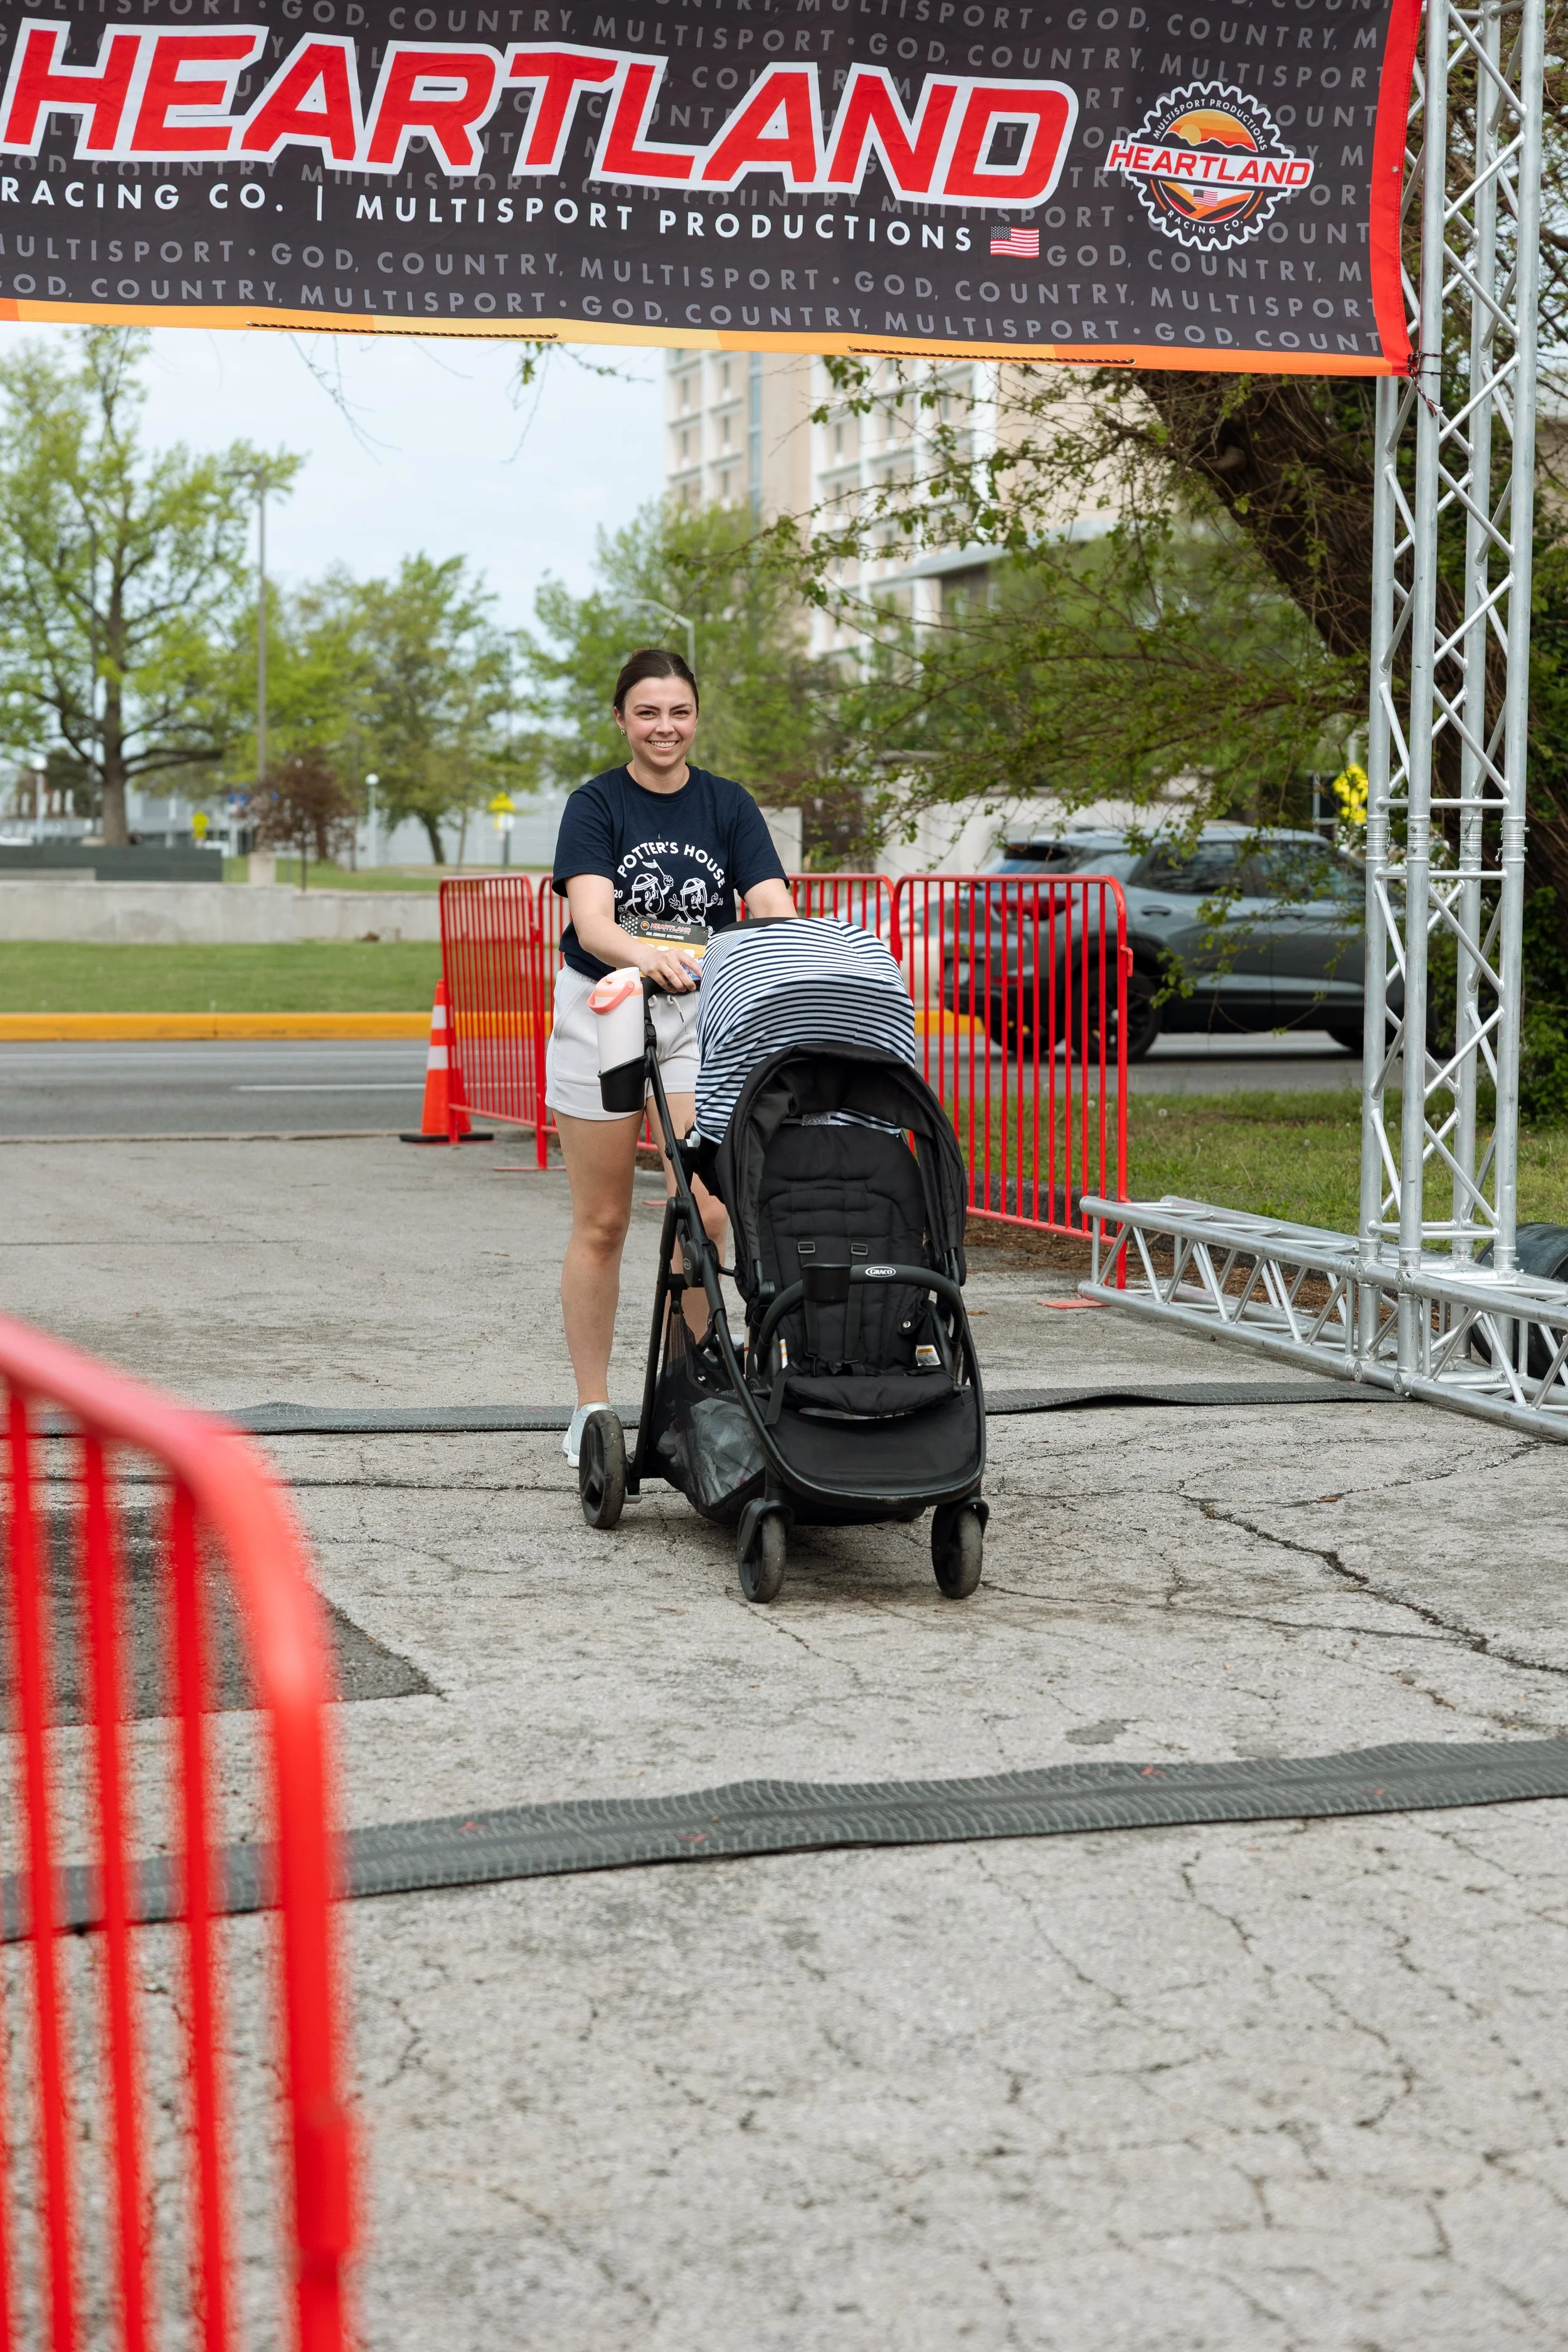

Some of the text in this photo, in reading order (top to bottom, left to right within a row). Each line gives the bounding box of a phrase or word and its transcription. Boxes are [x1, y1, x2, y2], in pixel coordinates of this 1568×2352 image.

[282, 0, 369, 28] GOD,
[389, 8, 576, 34] COUNTRY,
[593, 16, 834, 51] MULTISPORT
[869, 33, 949, 65] GOD,
[968, 44, 1145, 72] COUNTRY,
[1067, 8, 1150, 32] GOD,
[1167, 14, 1337, 50] COUNTRY,
[0, 17, 1079, 209] HEARTLAND
[1153, 98, 1205, 140] MULTISPORT
[1209, 98, 1267, 151] PRODUCTIONS
[1256, 103, 1377, 127] OUNT
[0, 154, 66, 174] OD
[1108, 144, 1310, 185] HEARTLAND
[1, 176, 971, 251] RACING CO. MULTISPORT PRODUCTIONS
[1167, 209, 1216, 235] RACING
[1224, 219, 1242, 232] CO.
[1249, 221, 1369, 244] OUNT
[0, 233, 233, 263] ULTISPORT
[272, 243, 359, 272] GOD,
[378, 252, 563, 277] COUNTRY,
[580, 257, 818, 290] MULTISPORT
[855, 271, 938, 300] GOD,
[955, 280, 1134, 306] COUNTRY,
[1047, 245, 1131, 268] GOD,
[1148, 249, 1322, 282] COUNTRY,
[0, 273, 1379, 351] OD, COUNTRY, MULTISPORT GOD, COUNTRY, MULTISPORT GOD, COUNT
[617, 842, 725, 888] POTTER'S HOUSE
[614, 889, 623, 898] 20
[650, 923, 691, 933] HEARTLAND
